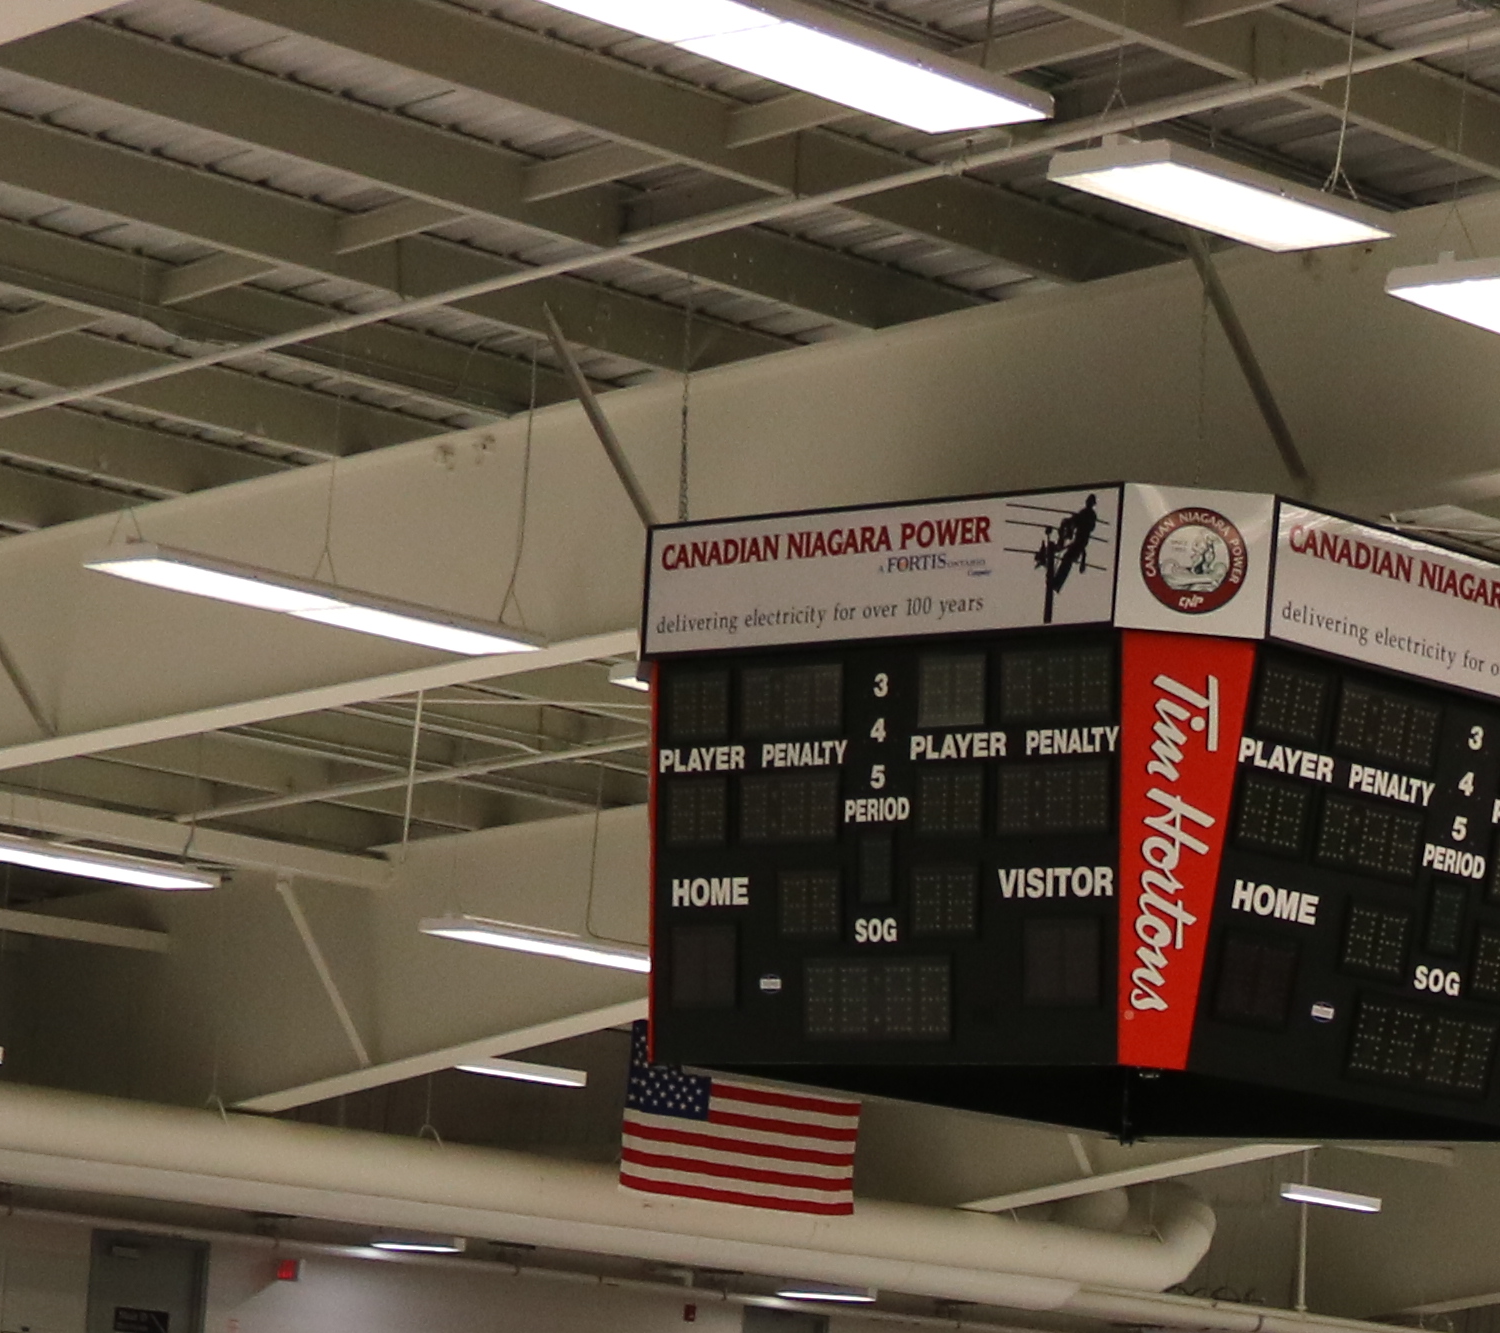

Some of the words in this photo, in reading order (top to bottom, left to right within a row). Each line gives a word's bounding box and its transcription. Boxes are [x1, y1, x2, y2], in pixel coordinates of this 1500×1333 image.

[662, 533, 781, 570] CANADIAN
[786, 525, 892, 561] NIAGARA
[900, 516, 990, 550] POWER
[1143, 514, 1177, 578] CANADIAN
[1178, 510, 1231, 538] NIAGARA
[1227, 538, 1243, 585] POWER
[1289, 525, 1413, 584] CANADIAN
[887, 554, 947, 573] FORTIS
[657, 603, 738, 636] delivering
[743, 601, 827, 629] electricity
[833, 601, 855, 622] for
[863, 602, 897, 619] over
[905, 596, 931, 617] 100
[939, 595, 984, 617] years
[1281, 601, 1370, 645] delivering
[1375, 625, 1457, 670] electricity
[1462, 649, 1486, 674] for
[873, 673, 889, 698] 3
[870, 718, 885, 743] 4
[910, 732, 1006, 760] PLAYER
[1025, 725, 1119, 755] PENALTY
[1143, 673, 1218, 784] Tim
[1468, 726, 1484, 750] 3
[660, 746, 745, 773] PLAYER
[762, 739, 847, 767] PENALTY
[1238, 737, 1335, 783] PLAYER
[1349, 763, 1435, 806] PENALTY
[870, 765, 885, 789] 5
[1458, 772, 1473, 796] 4
[844, 797, 910, 823] PERIOD
[1451, 816, 1467, 841] 5
[1422, 844, 1486, 880] PERIOD
[672, 877, 749, 907] HOME
[998, 866, 1113, 899] VISITOR
[1130, 788, 1217, 1014] Hortons
[1231, 880, 1320, 925] HOME
[855, 918, 898, 942] SOG
[1413, 966, 1460, 995] SOG
